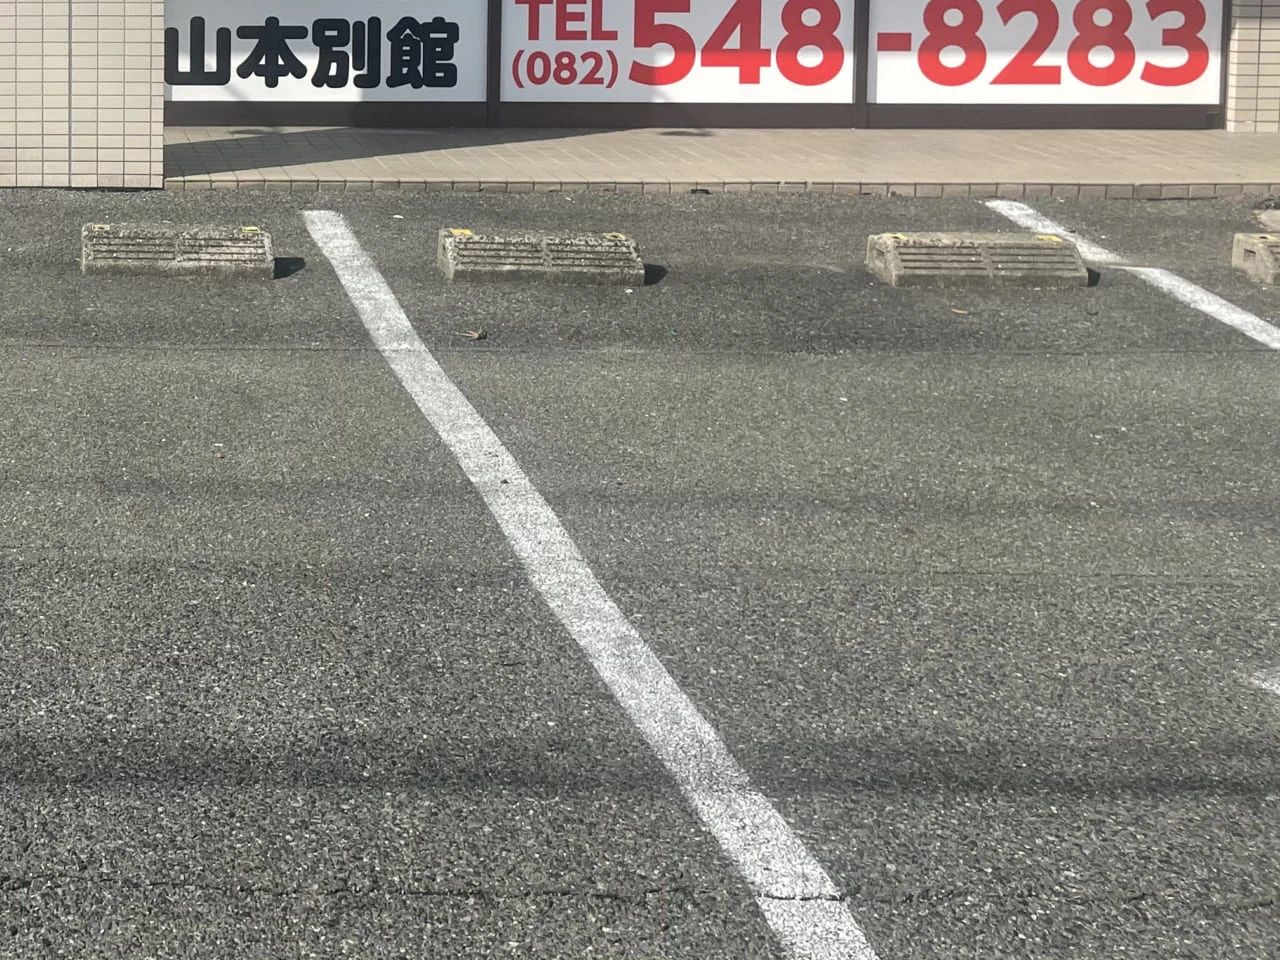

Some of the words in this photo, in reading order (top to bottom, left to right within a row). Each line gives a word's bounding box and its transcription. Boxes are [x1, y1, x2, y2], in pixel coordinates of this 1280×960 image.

[164, 16, 460, 90] 山本別館
[511, 49, 619, 90] (082)
